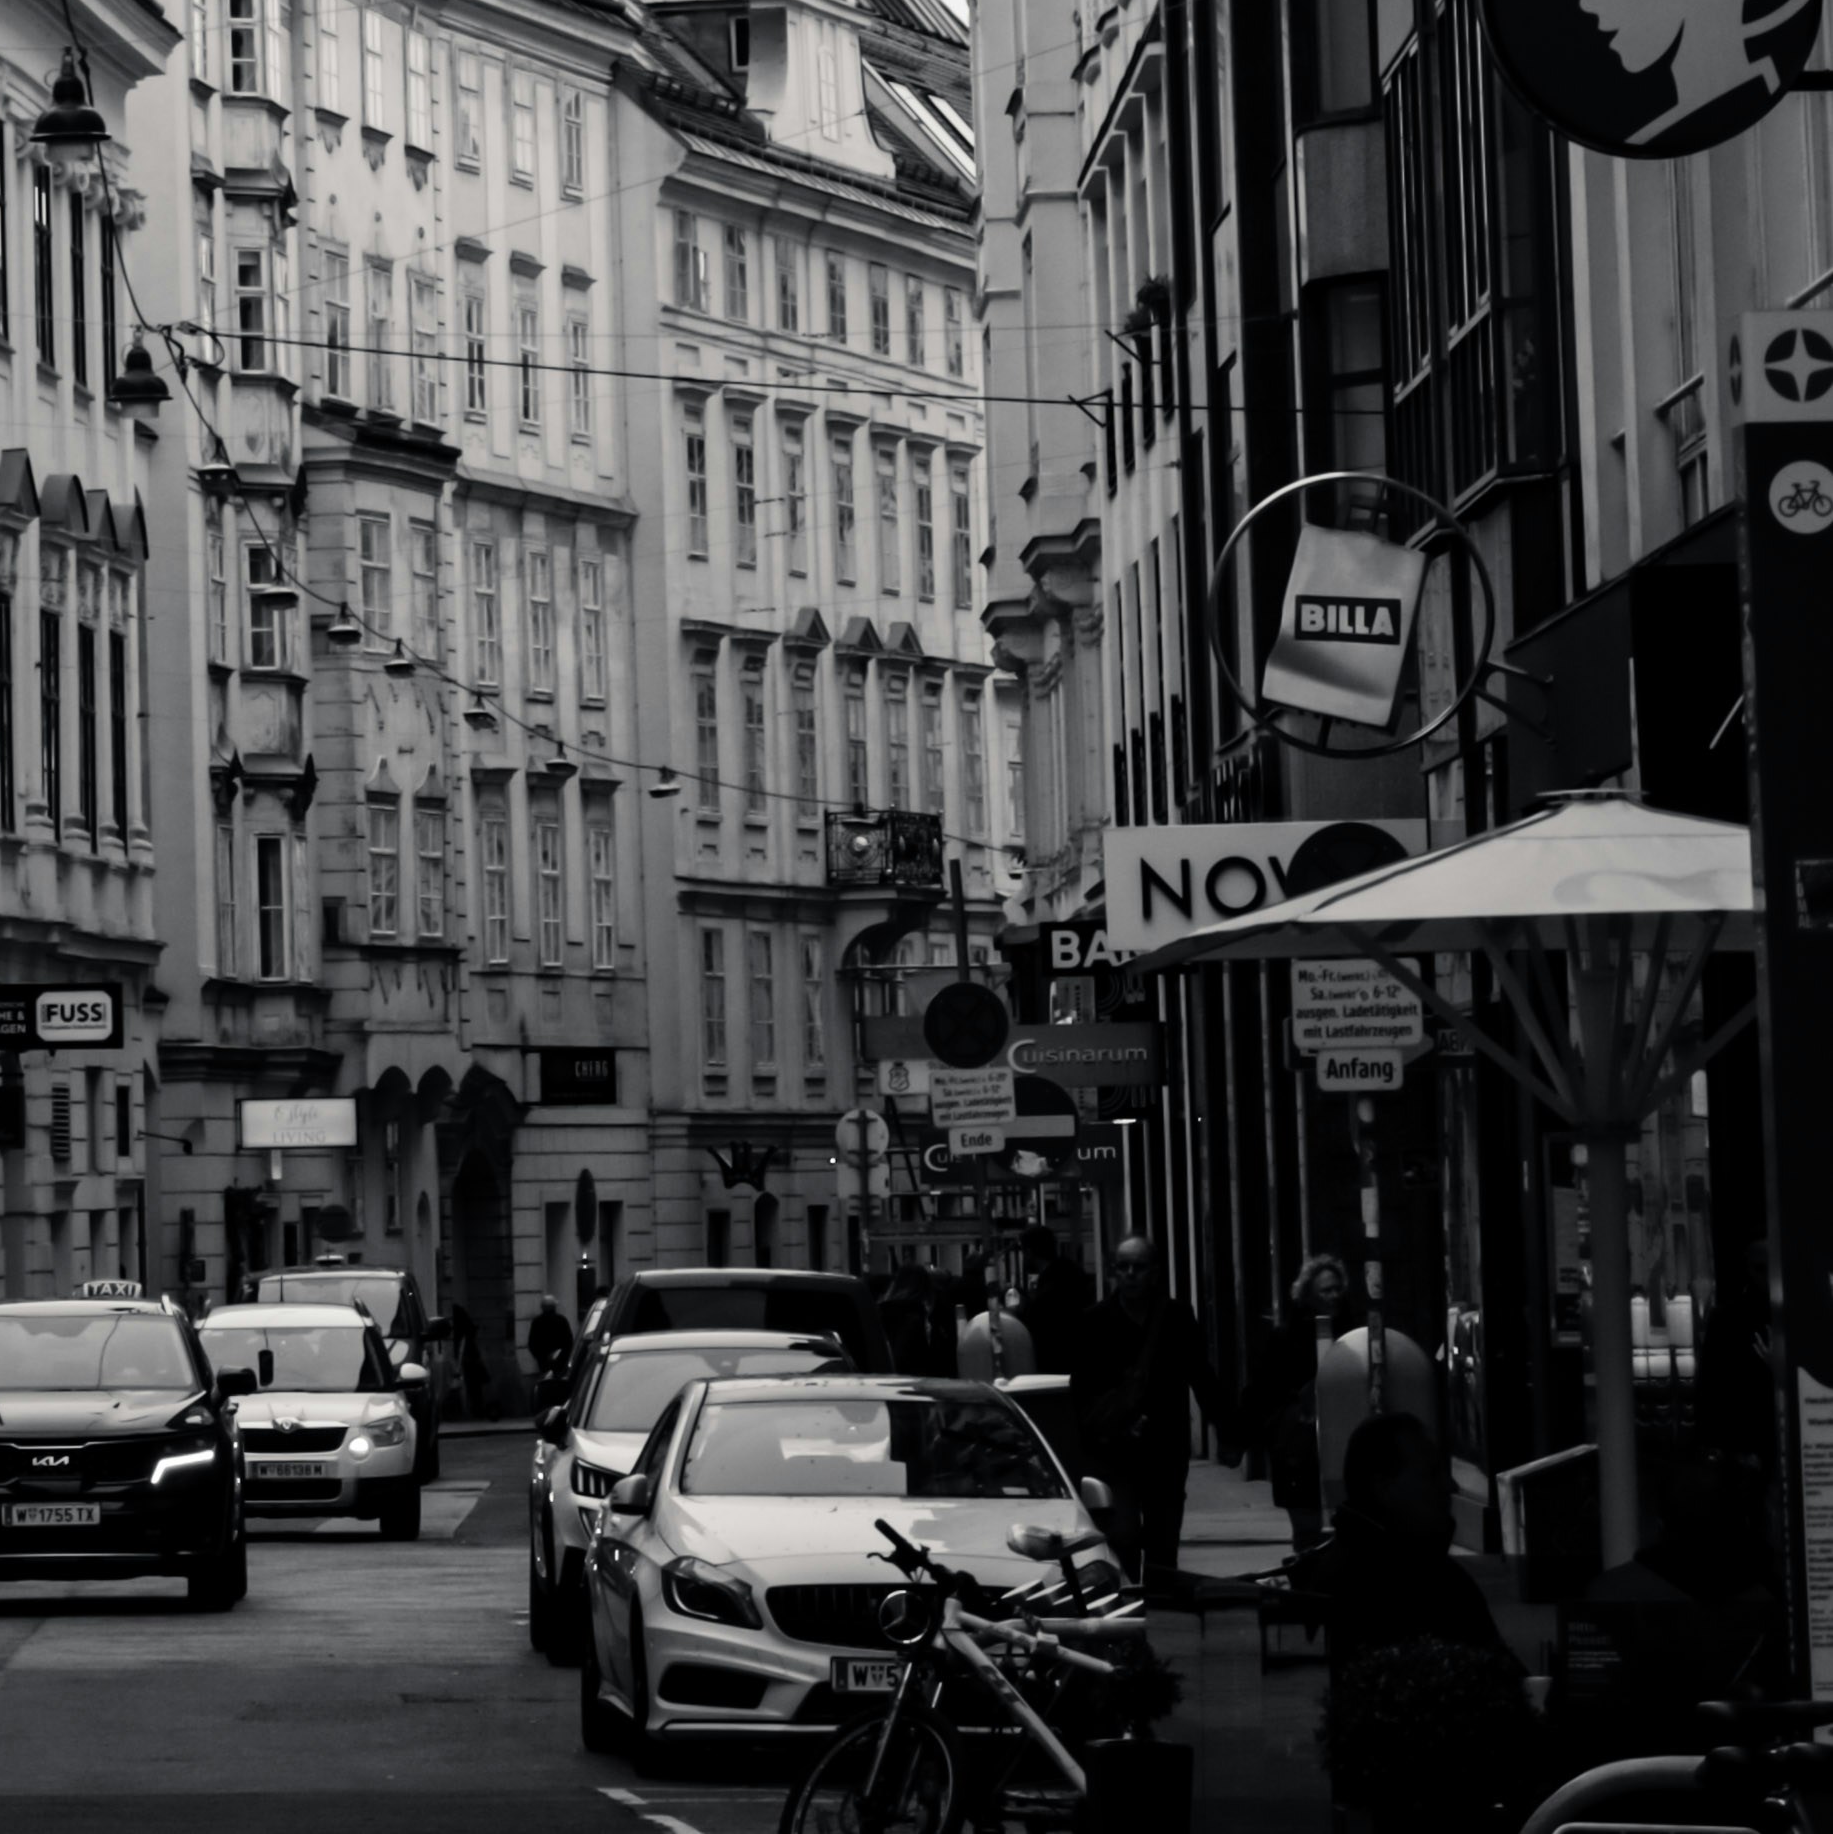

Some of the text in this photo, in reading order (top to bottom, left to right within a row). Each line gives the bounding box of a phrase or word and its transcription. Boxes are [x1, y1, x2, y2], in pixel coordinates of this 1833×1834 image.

[1300, 602, 1395, 636] BILLA
[47, 1002, 103, 1023] FUSS
[1303, 1024, 1412, 1039] mit Lastfahrzeugen
[1006, 1038, 1148, 1074] Cuisinarum
[1325, 1057, 1394, 1084] Anfang
[960, 1132, 993, 1148] Ende
[91, 1283, 134, 1296] TAXI
[16, 1505, 96, 1523] W 1755 TX
[852, 1665, 866, 1687] W
